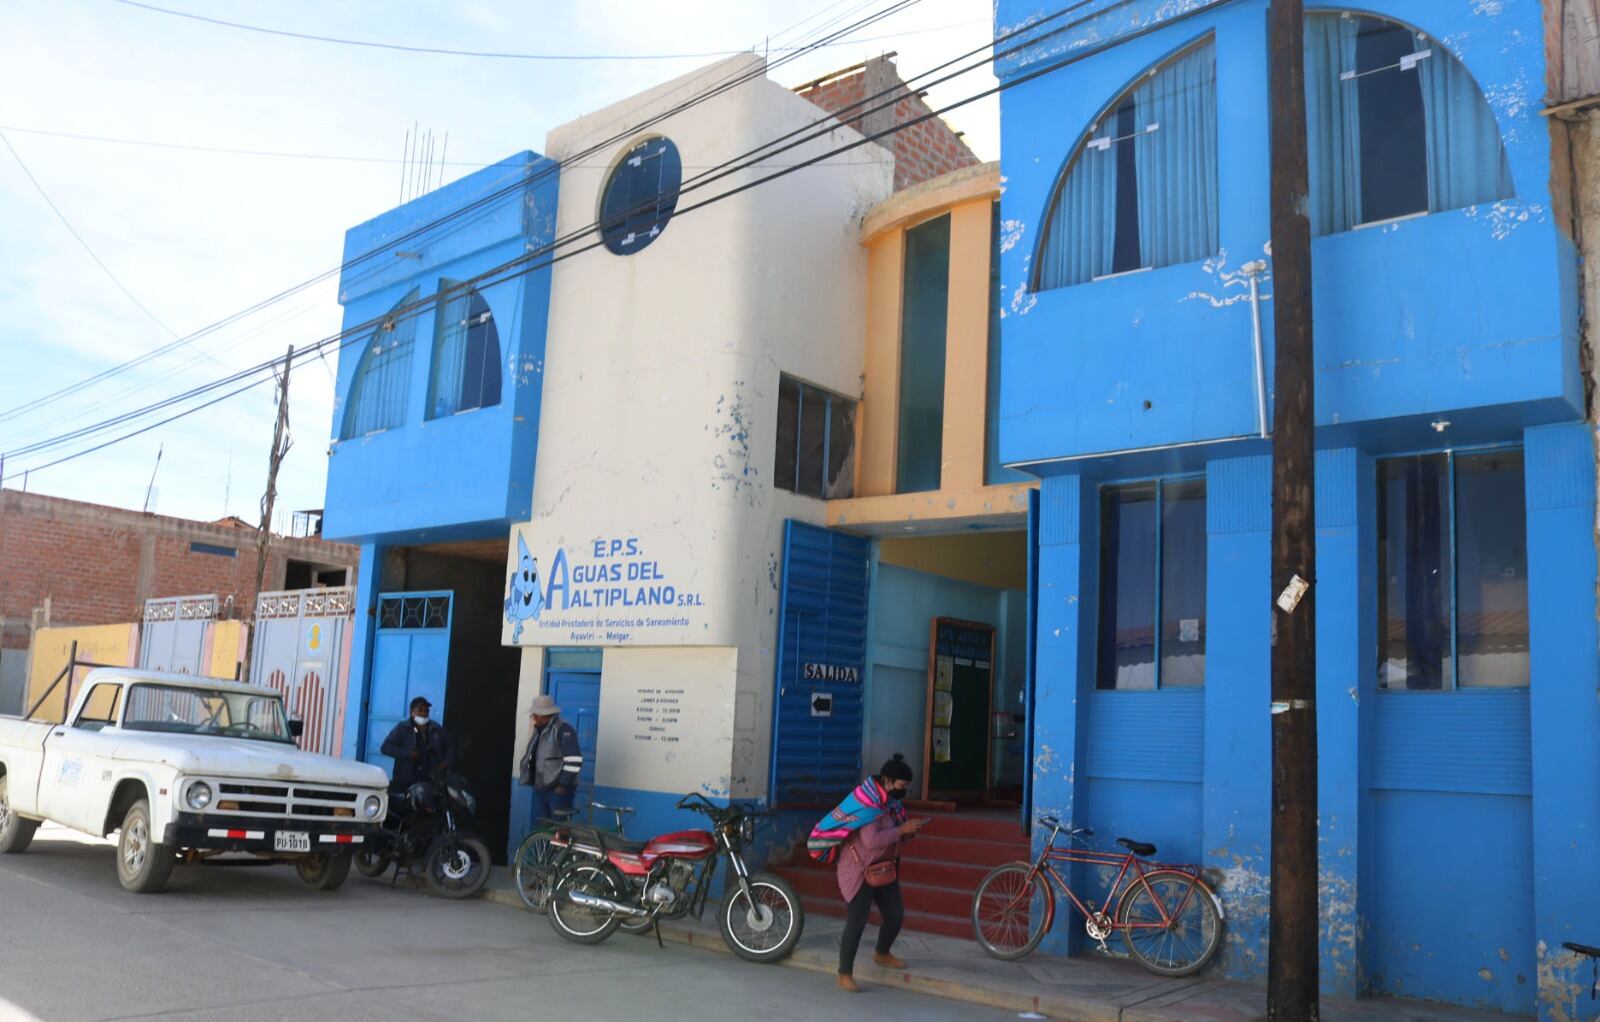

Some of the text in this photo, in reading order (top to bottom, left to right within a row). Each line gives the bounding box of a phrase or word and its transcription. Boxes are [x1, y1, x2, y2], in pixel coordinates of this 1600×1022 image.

[594, 538, 643, 558] E.P.S.
[627, 561, 664, 580] DEL
[570, 586, 705, 608] ALTIPLANO S.R.L.
[539, 617, 689, 628] Entidad Prestadora de Servicios de Saneamiento
[570, 631, 595, 641] Ayaviri
[806, 663, 856, 683] SALIDA
